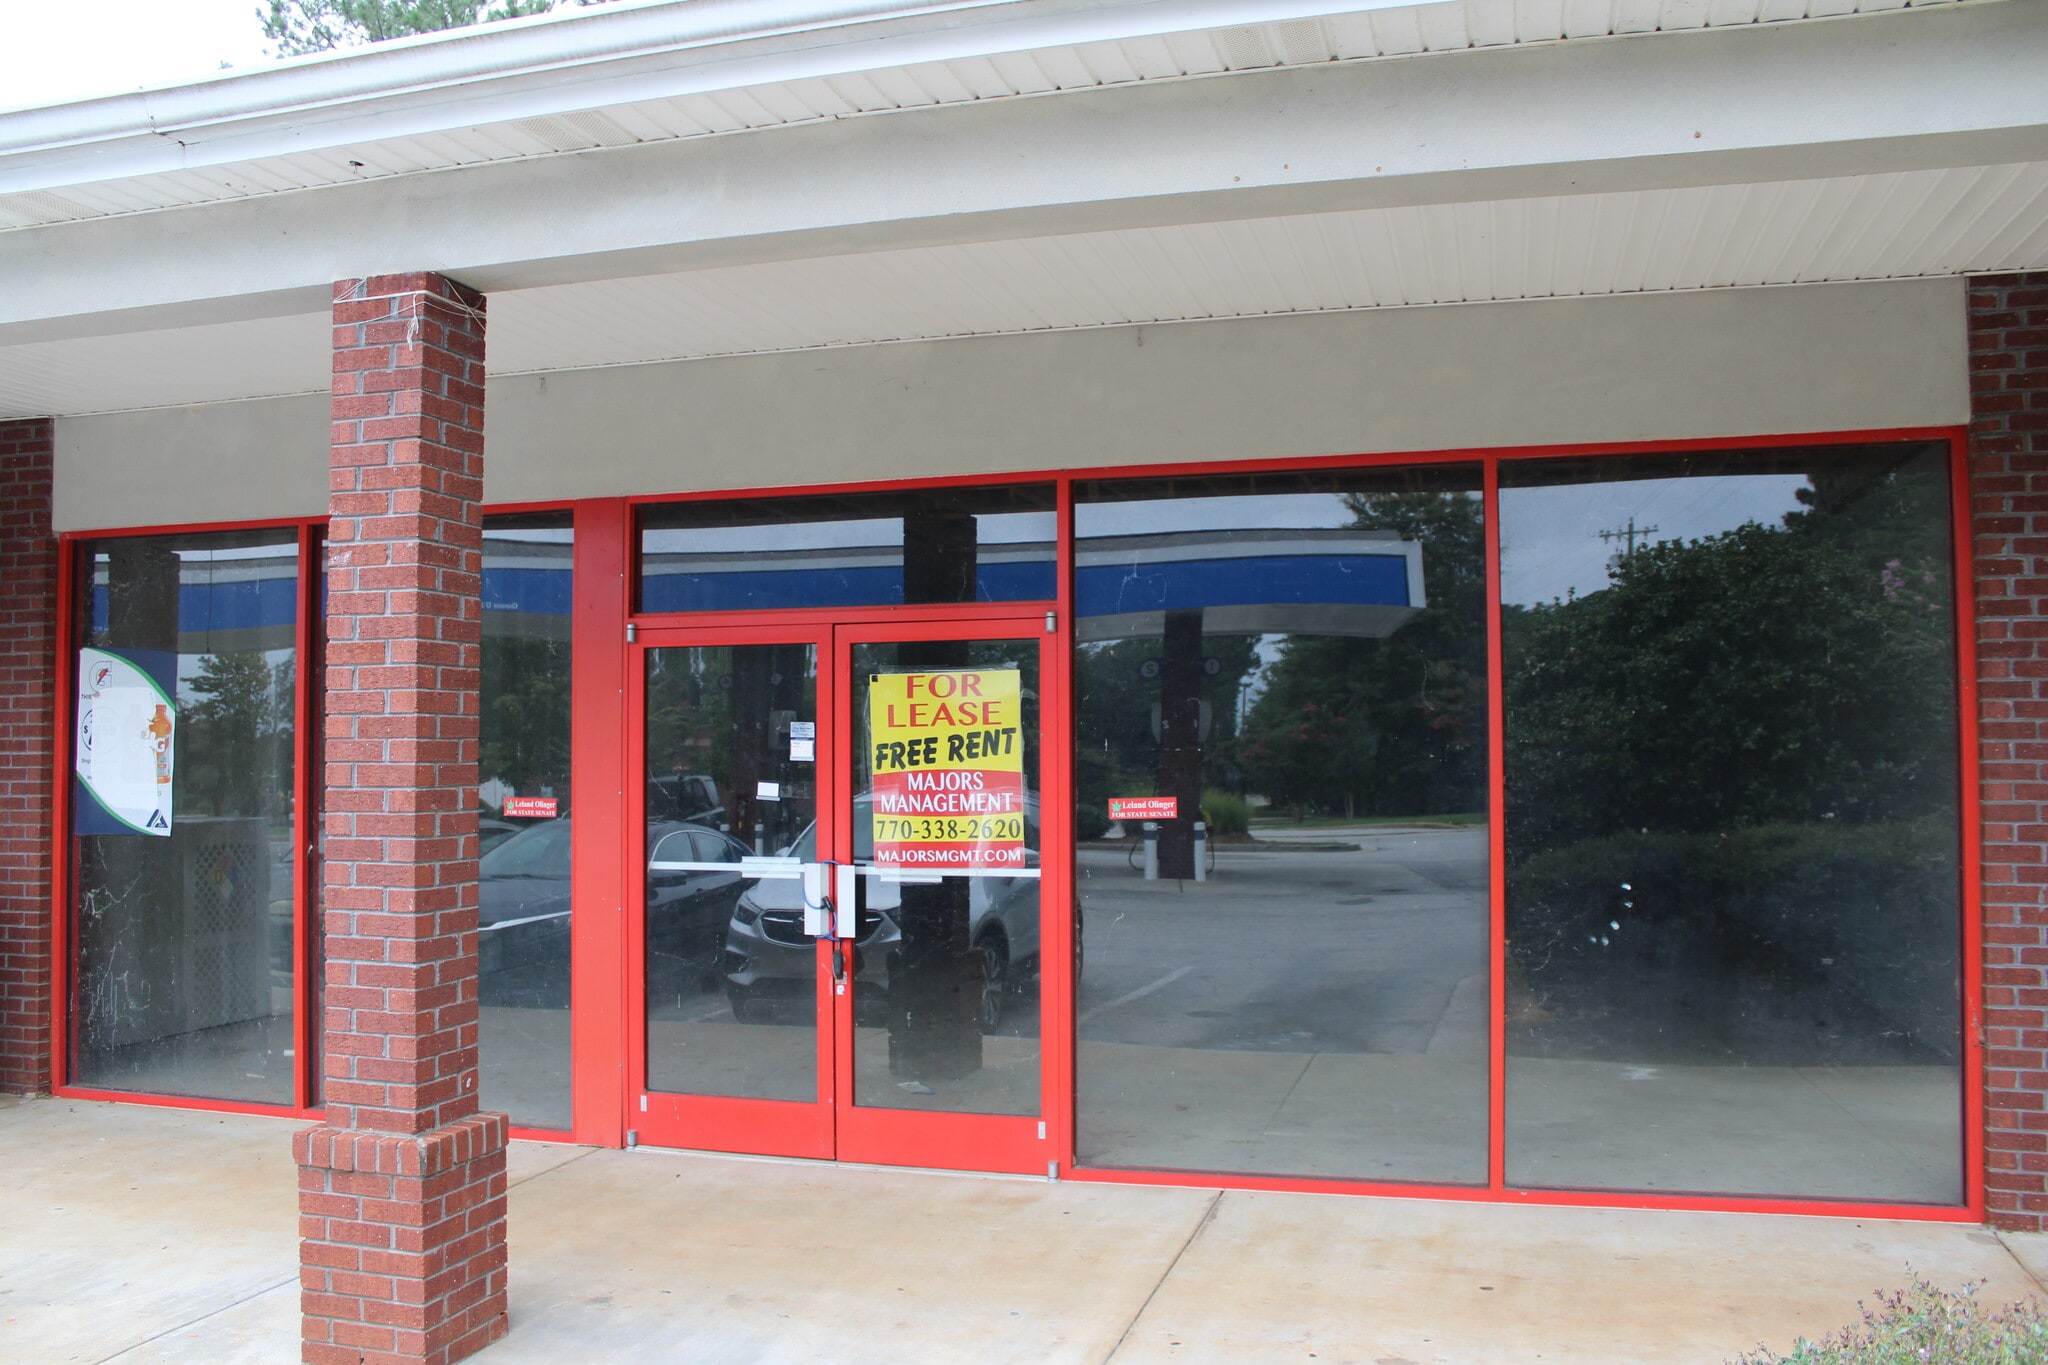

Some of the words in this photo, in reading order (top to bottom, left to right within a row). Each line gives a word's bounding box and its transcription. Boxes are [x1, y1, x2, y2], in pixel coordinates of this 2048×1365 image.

[906, 673, 983, 699] FOR
[887, 701, 1002, 728] LEASE
[875, 737, 938, 770] FREE
[948, 727, 1017, 763] RENT
[907, 771, 984, 791] MAJORS
[515, 800, 533, 808] Leland
[535, 800, 556, 810] Olinger
[880, 792, 1014, 813] MANAGEMENT
[1122, 800, 1147, 809] Leland
[1148, 801, 1175, 811] Olinger
[876, 818, 1021, 840] 770-338-2620
[877, 849, 1021, 862] MAJORSMGMT.COM
